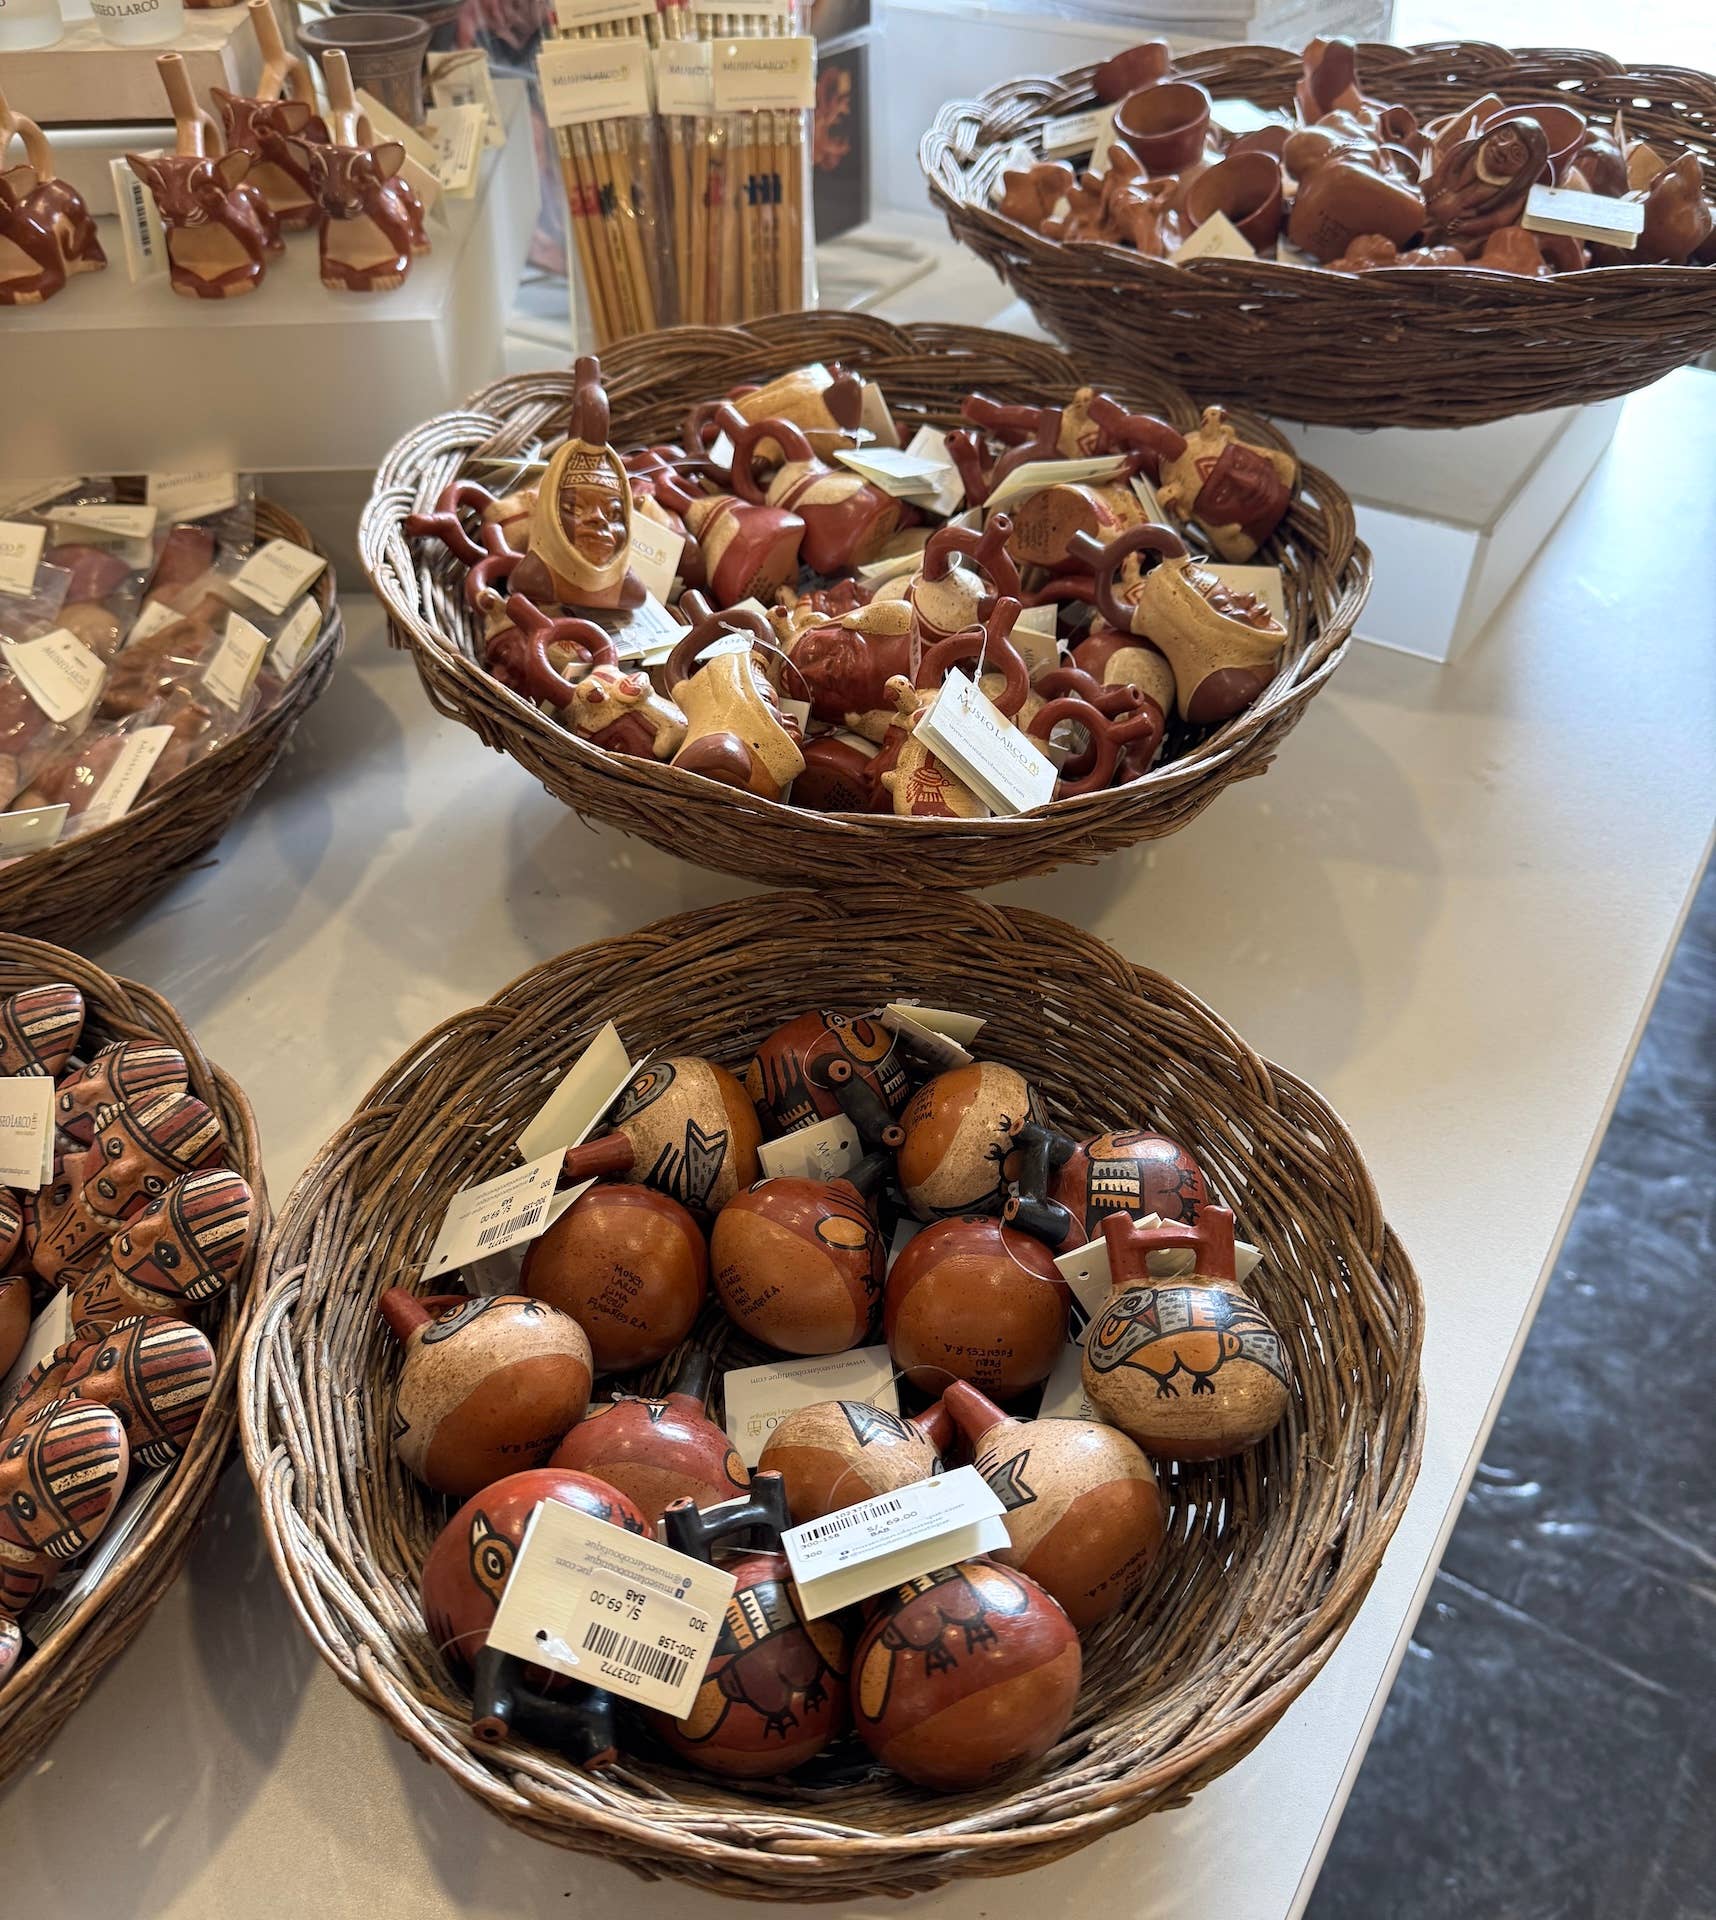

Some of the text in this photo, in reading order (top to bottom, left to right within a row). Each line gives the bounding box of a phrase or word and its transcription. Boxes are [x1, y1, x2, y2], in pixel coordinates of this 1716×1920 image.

[117, 0, 159, 17] LARCO
[994, 730, 1029, 766] LARCO
[750, 1359, 866, 1384] www.museolarcoboutique.com
[886, 1511, 918, 1526] 69.00
[804, 1550, 823, 1559] 300
[590, 1590, 642, 1621] S/. 69.00
[626, 1589, 646, 1606] BAB
[689, 1616, 708, 1633] 300
[658, 1635, 697, 1660] 300-158
[600, 1661, 642, 1686] 1023772
